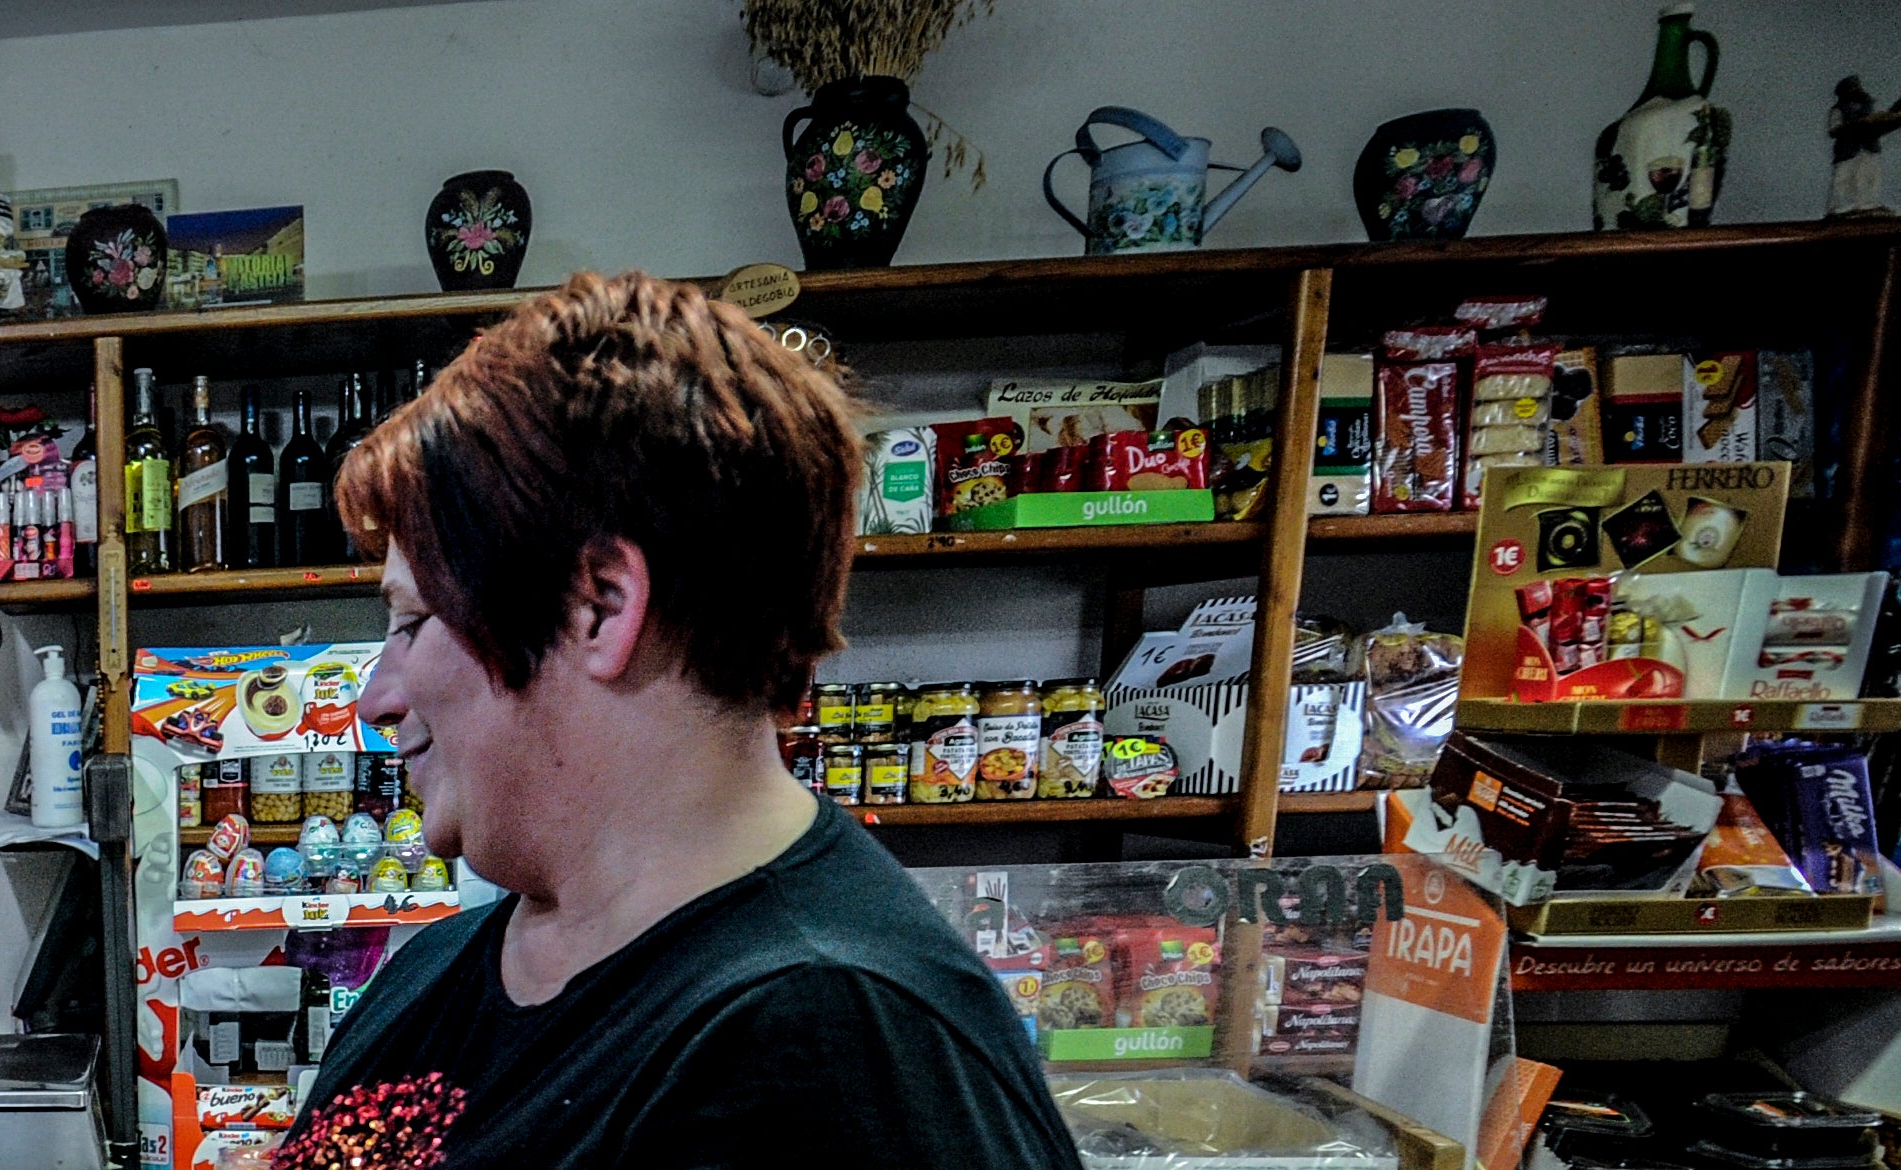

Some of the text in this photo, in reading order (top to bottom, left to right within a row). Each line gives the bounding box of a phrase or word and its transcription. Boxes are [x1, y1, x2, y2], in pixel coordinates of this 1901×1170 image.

[729, 271, 790, 293] ARTESANIA
[736, 285, 796, 308] ALDEGOBIA
[998, 382, 1053, 403] Lazos
[1061, 385, 1082, 402] de
[992, 437, 1011, 451] 1€
[1181, 434, 1205, 452] 1€
[1126, 446, 1167, 474] Duo
[950, 466, 979, 482] Choco
[1667, 465, 1776, 491] FERRERO
[1083, 494, 1148, 520] gullón
[1497, 546, 1519, 567] 1€
[1141, 645, 1175, 666] 1€
[1135, 705, 1171, 719] LACASA
[1118, 742, 1143, 757] 1€
[1827, 768, 1867, 839] Milka
[1515, 954, 1901, 975] Descubre un universo de sabores
[1141, 971, 1212, 990] Choco Chips
[1115, 1031, 1184, 1056] gullón
[209, 1086, 256, 1108] bueno
